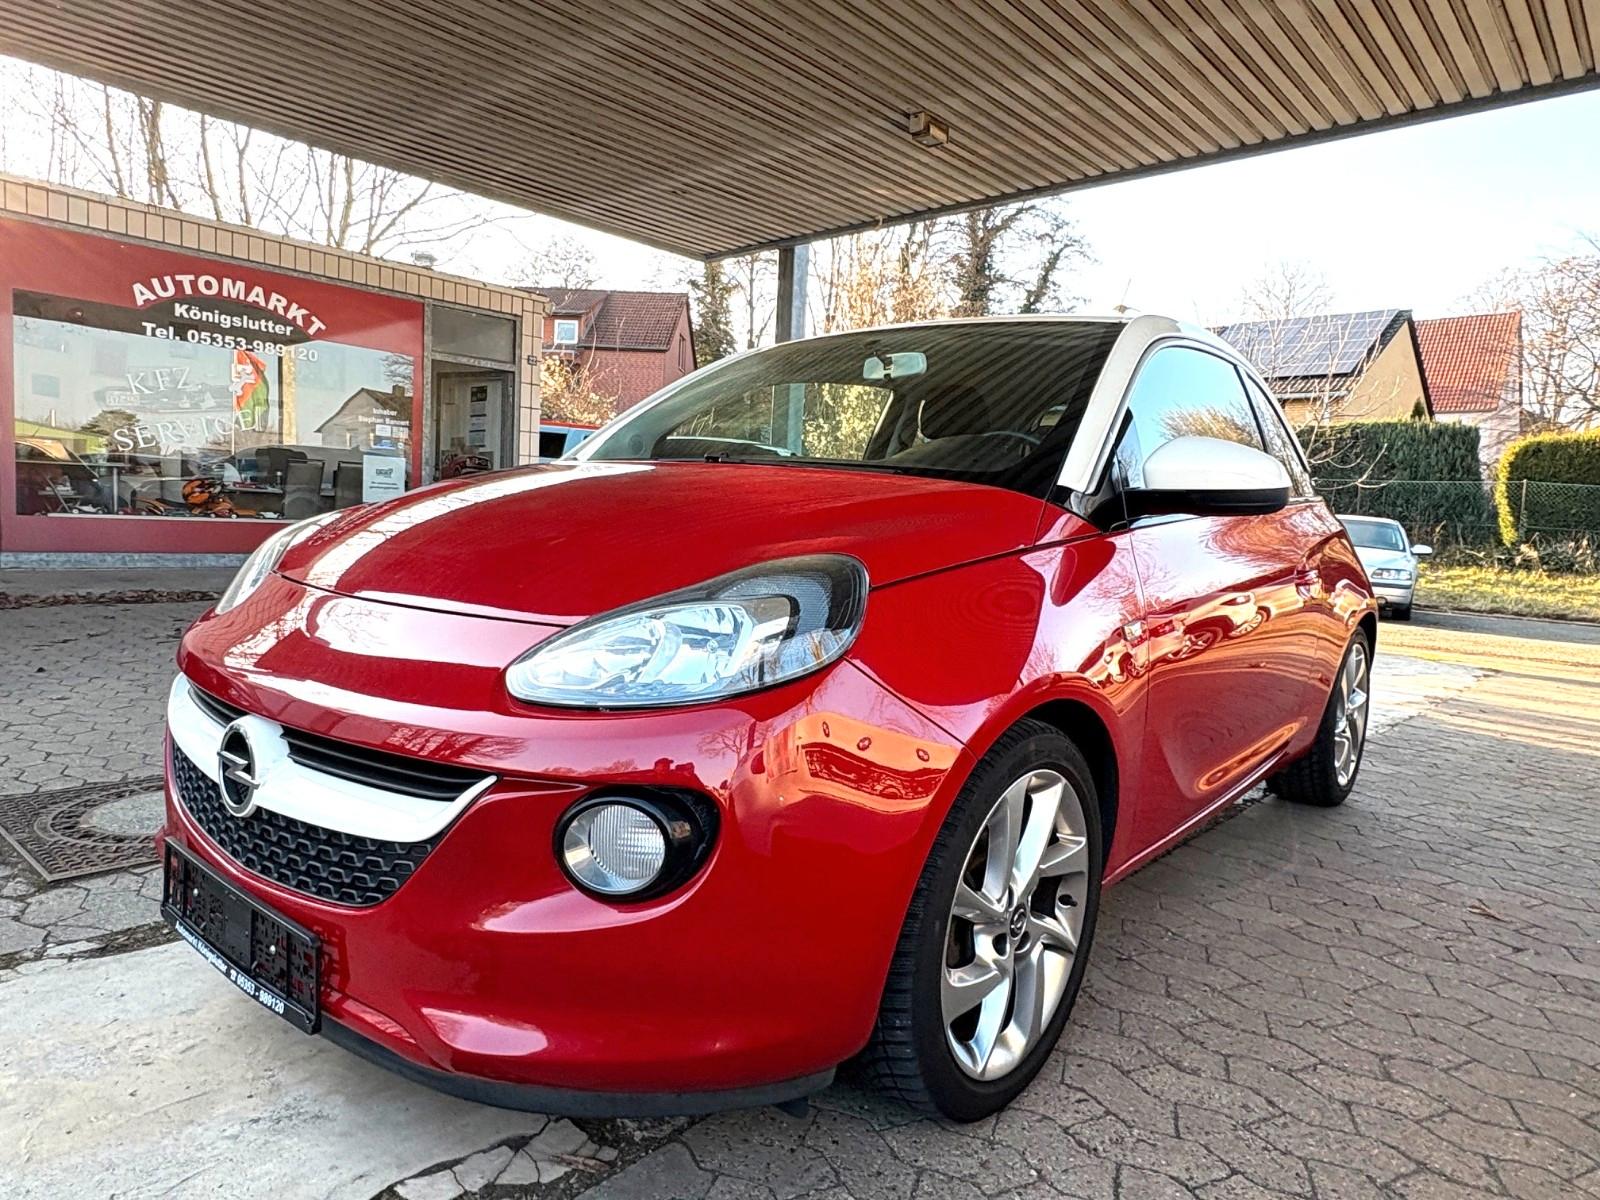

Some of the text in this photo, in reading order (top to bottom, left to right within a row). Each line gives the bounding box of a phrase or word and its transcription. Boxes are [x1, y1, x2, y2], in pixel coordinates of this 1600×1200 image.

[132, 274, 326, 336] AUTOMARKT
[174, 302, 294, 337] Königslutter
[142, 321, 319, 362] Tel. 05353-989120
[113, 409, 256, 452] SERVICE
